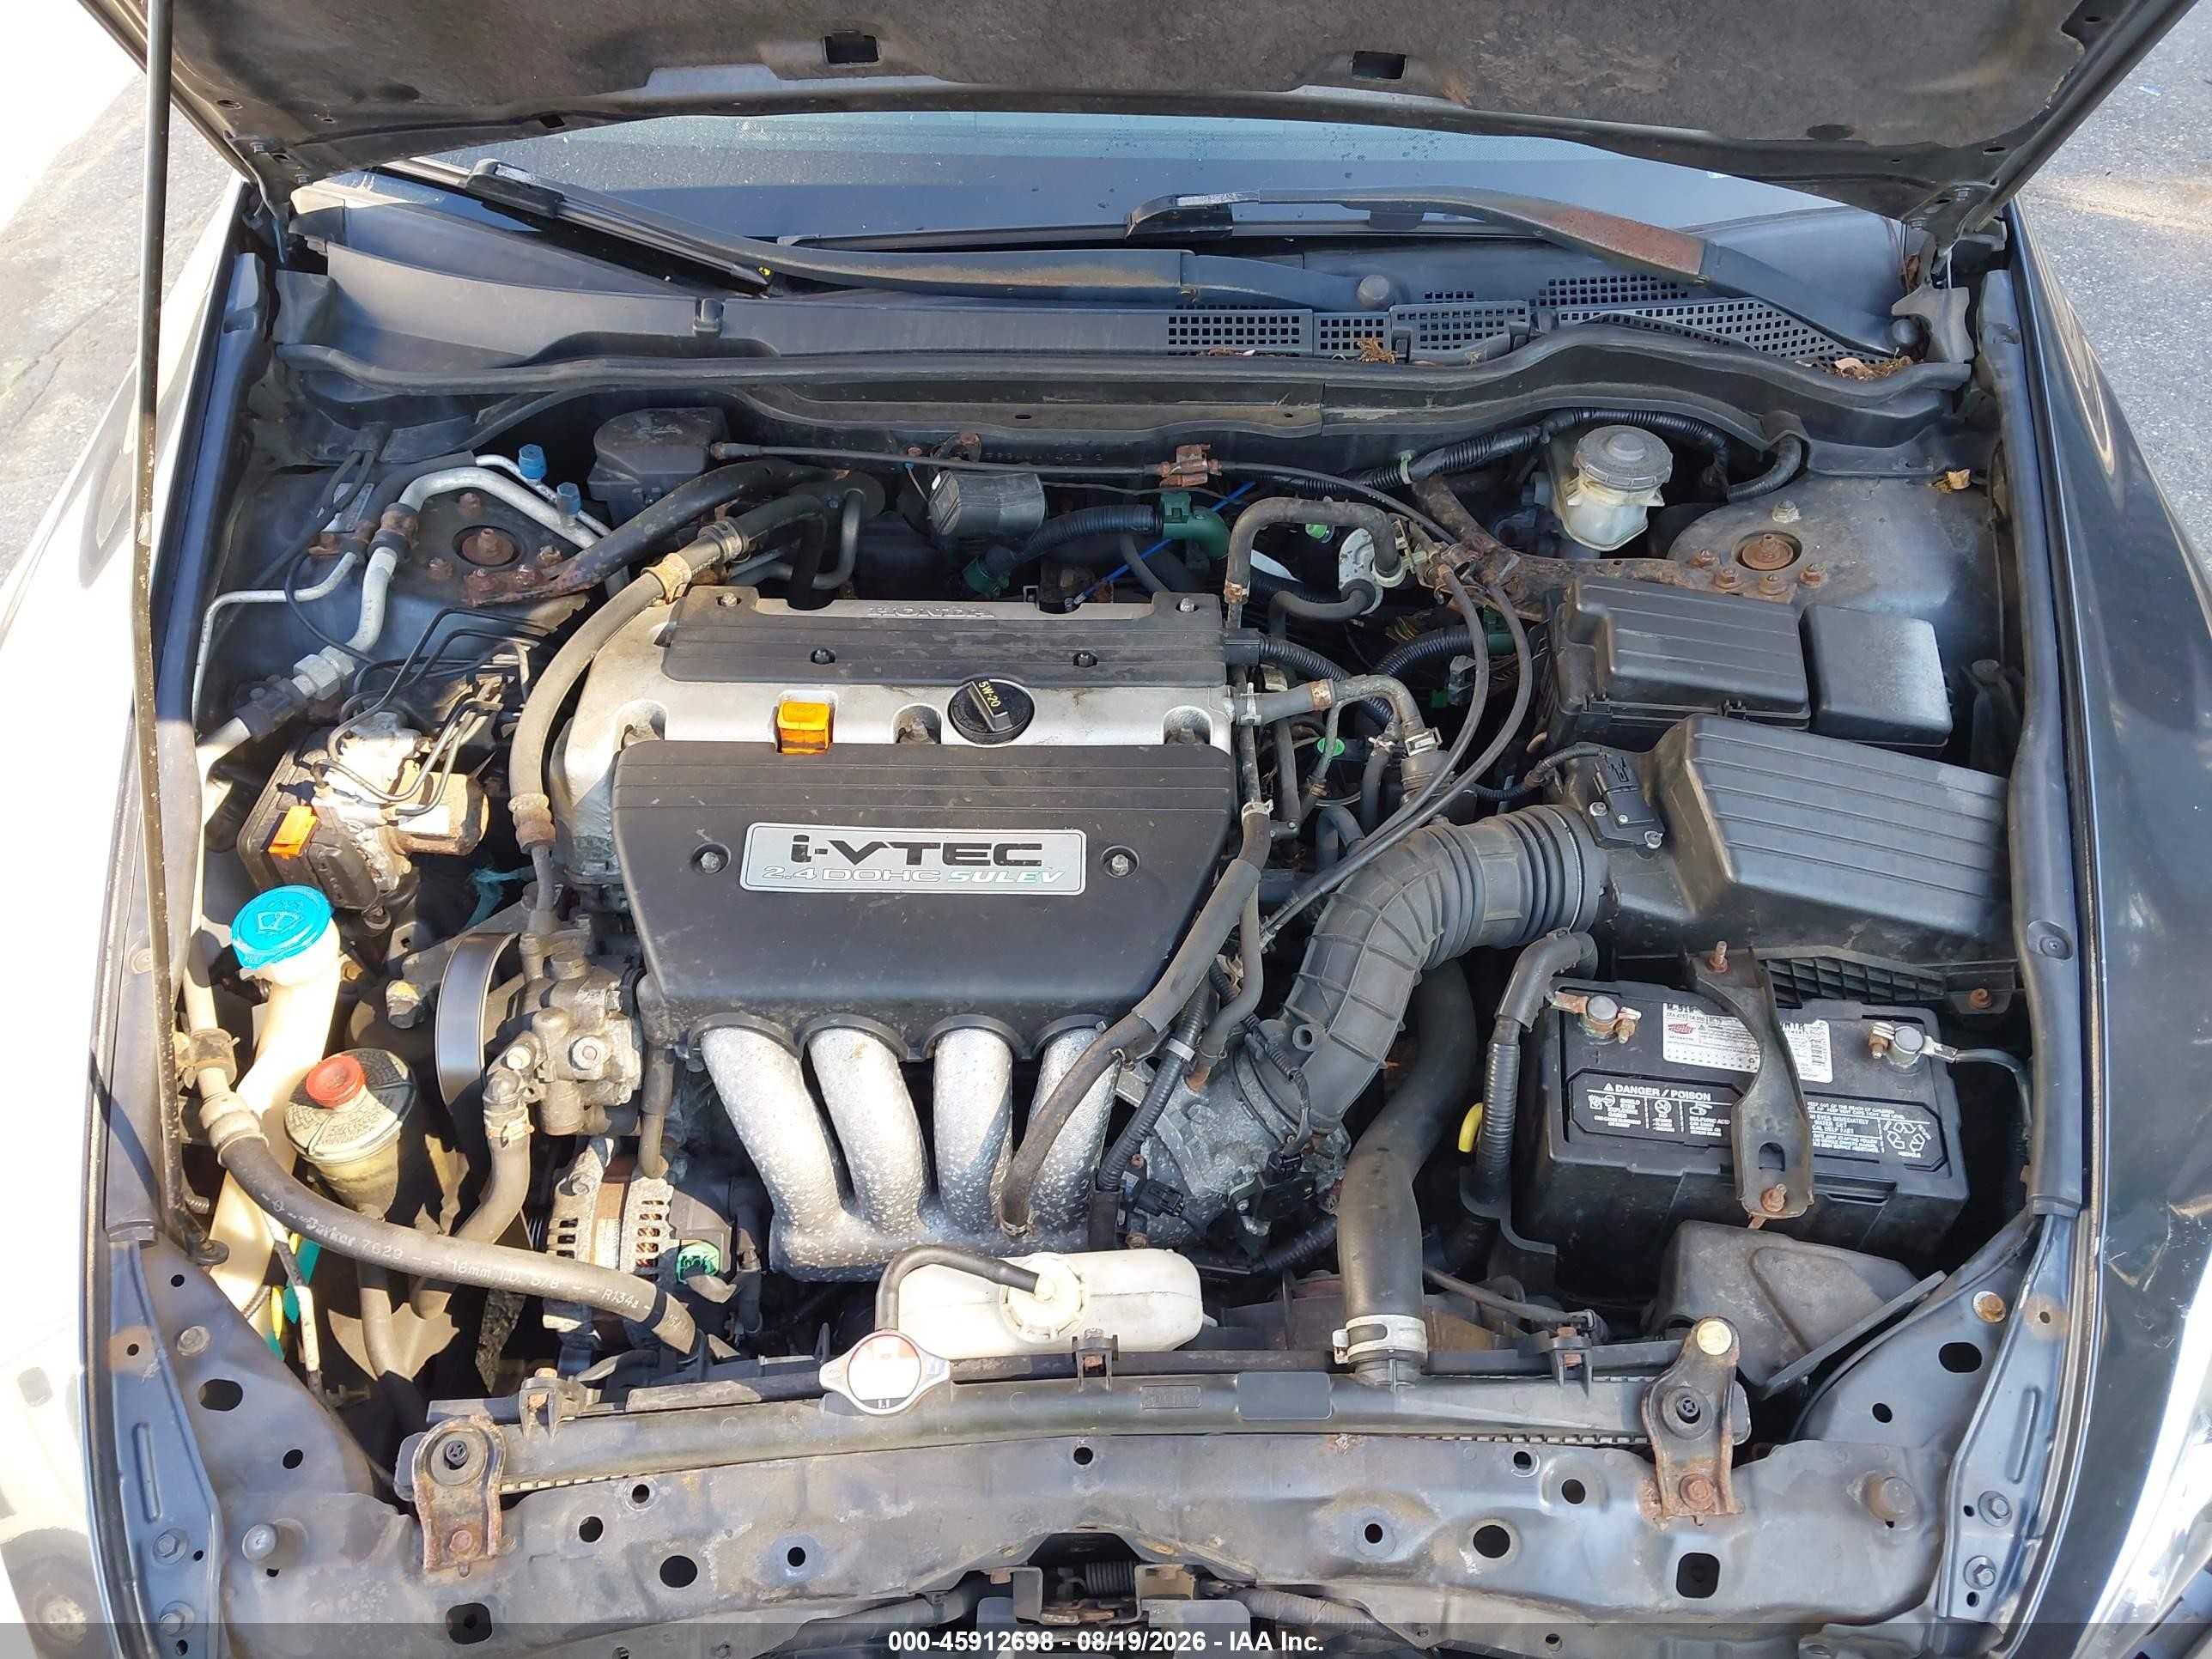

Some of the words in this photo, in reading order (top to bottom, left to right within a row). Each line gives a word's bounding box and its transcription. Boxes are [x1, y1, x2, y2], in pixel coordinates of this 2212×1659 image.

[978, 680, 1002, 708] 5W-20
[790, 833, 1042, 867] i-VTEC
[762, 865, 817, 881] 2.4
[821, 868, 942, 883] DOHC
[946, 869, 1066, 884] SULEV
[1614, 1084, 1660, 1097] DANGER
[1670, 1090, 1711, 1102] POISON
[601, 1288, 640, 1310] R134a
